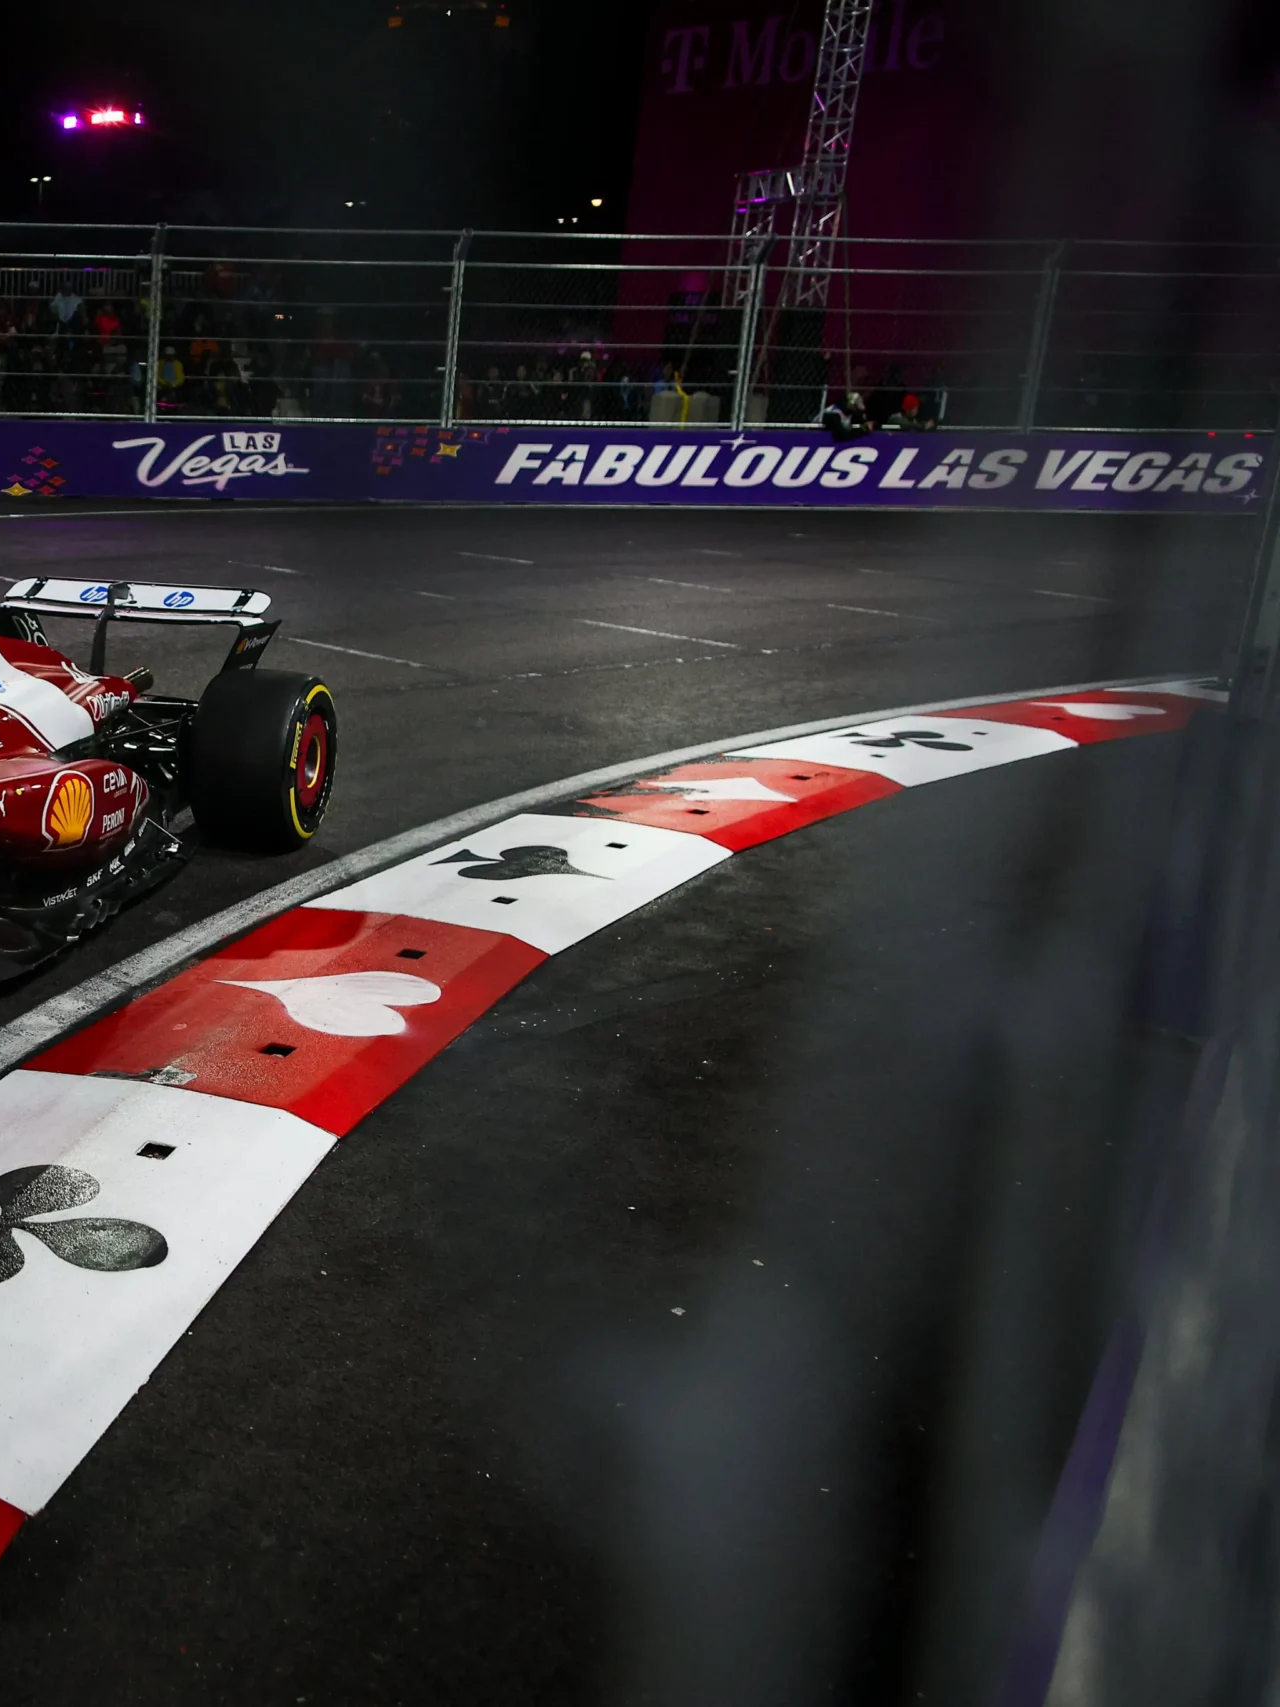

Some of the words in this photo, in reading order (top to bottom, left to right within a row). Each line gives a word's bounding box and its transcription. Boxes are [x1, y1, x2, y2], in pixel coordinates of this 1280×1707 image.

[720, 0, 946, 89] Moile
[227, 434, 277, 451] LAS
[112, 434, 310, 490] Vegas
[495, 443, 879, 488] FABULOUS
[878, 448, 1028, 490] LAS
[1036, 450, 1263, 493] VEGAS
[81, 586, 108, 602] hp
[164, 591, 194, 608] hp
[101, 807, 125, 834] PERONI
[86, 868, 103, 887] SKF
